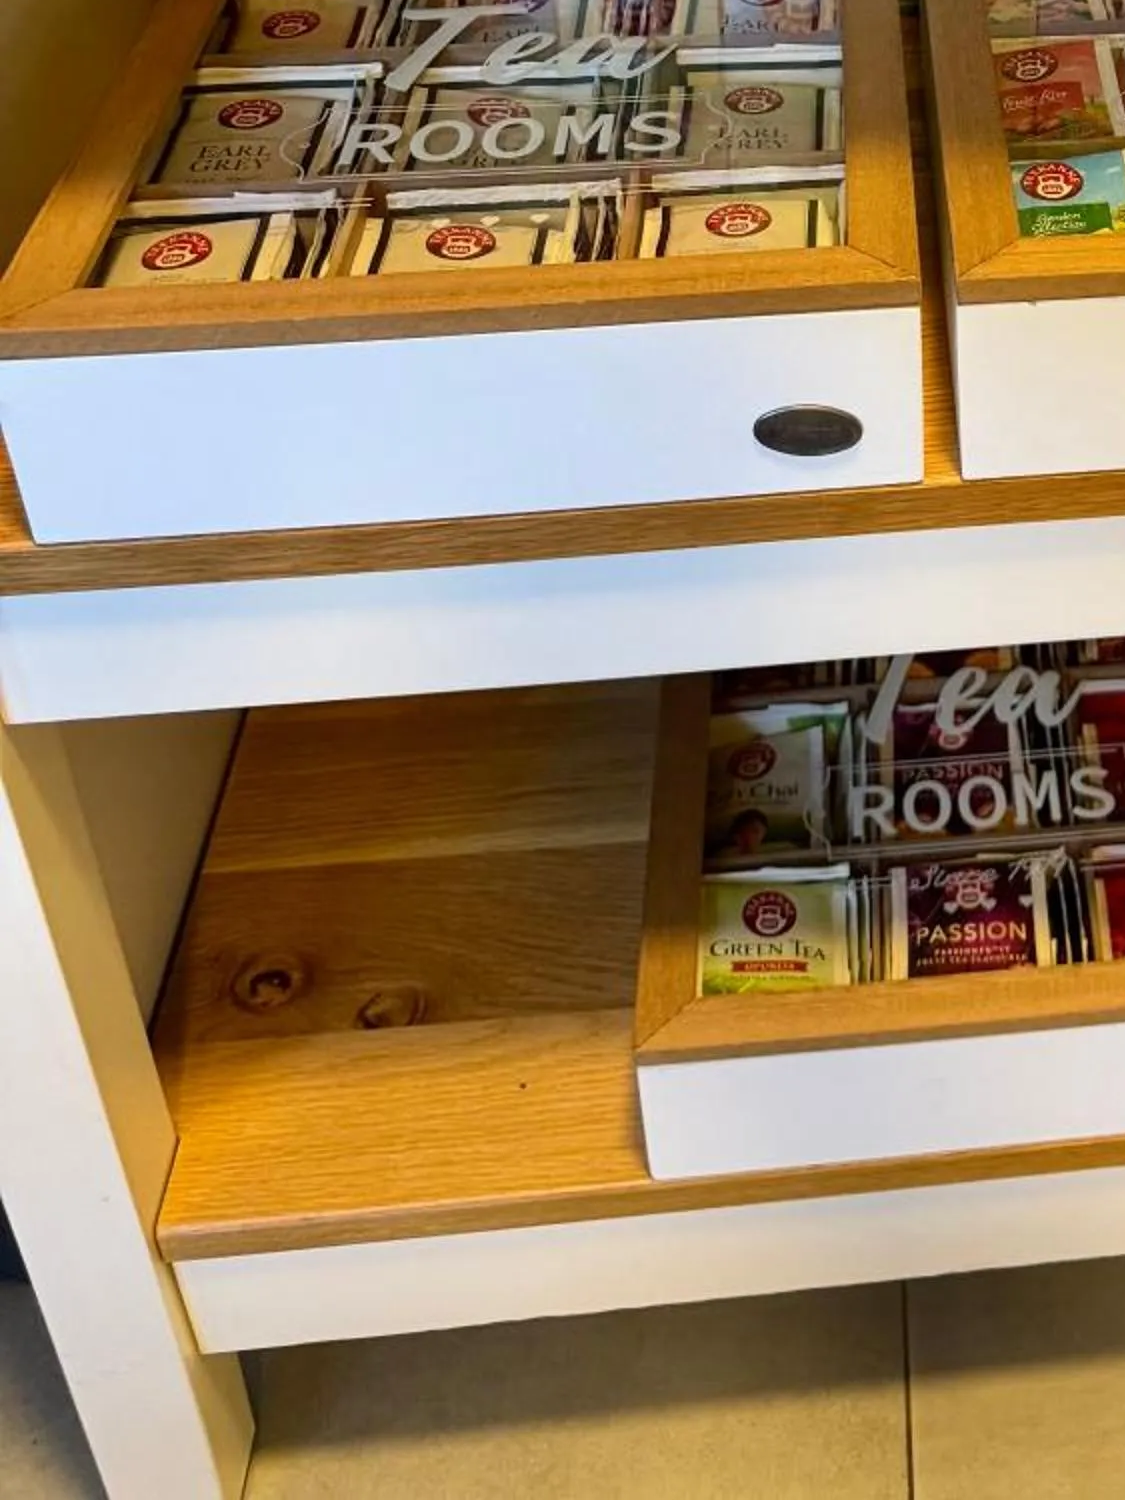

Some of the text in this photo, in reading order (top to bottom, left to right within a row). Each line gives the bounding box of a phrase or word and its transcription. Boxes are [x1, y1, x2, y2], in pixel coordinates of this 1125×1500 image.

[384, 3, 679, 92] Tea
[334, 112, 682, 167] ROOMS
[200, 144, 270, 159] EARL
[189, 158, 264, 173] GREY
[903, 762, 1004, 781] PASSION
[850, 767, 1116, 837] ROOMS
[916, 921, 1027, 945] PASSION
[709, 938, 825, 961] GREEN TEA
